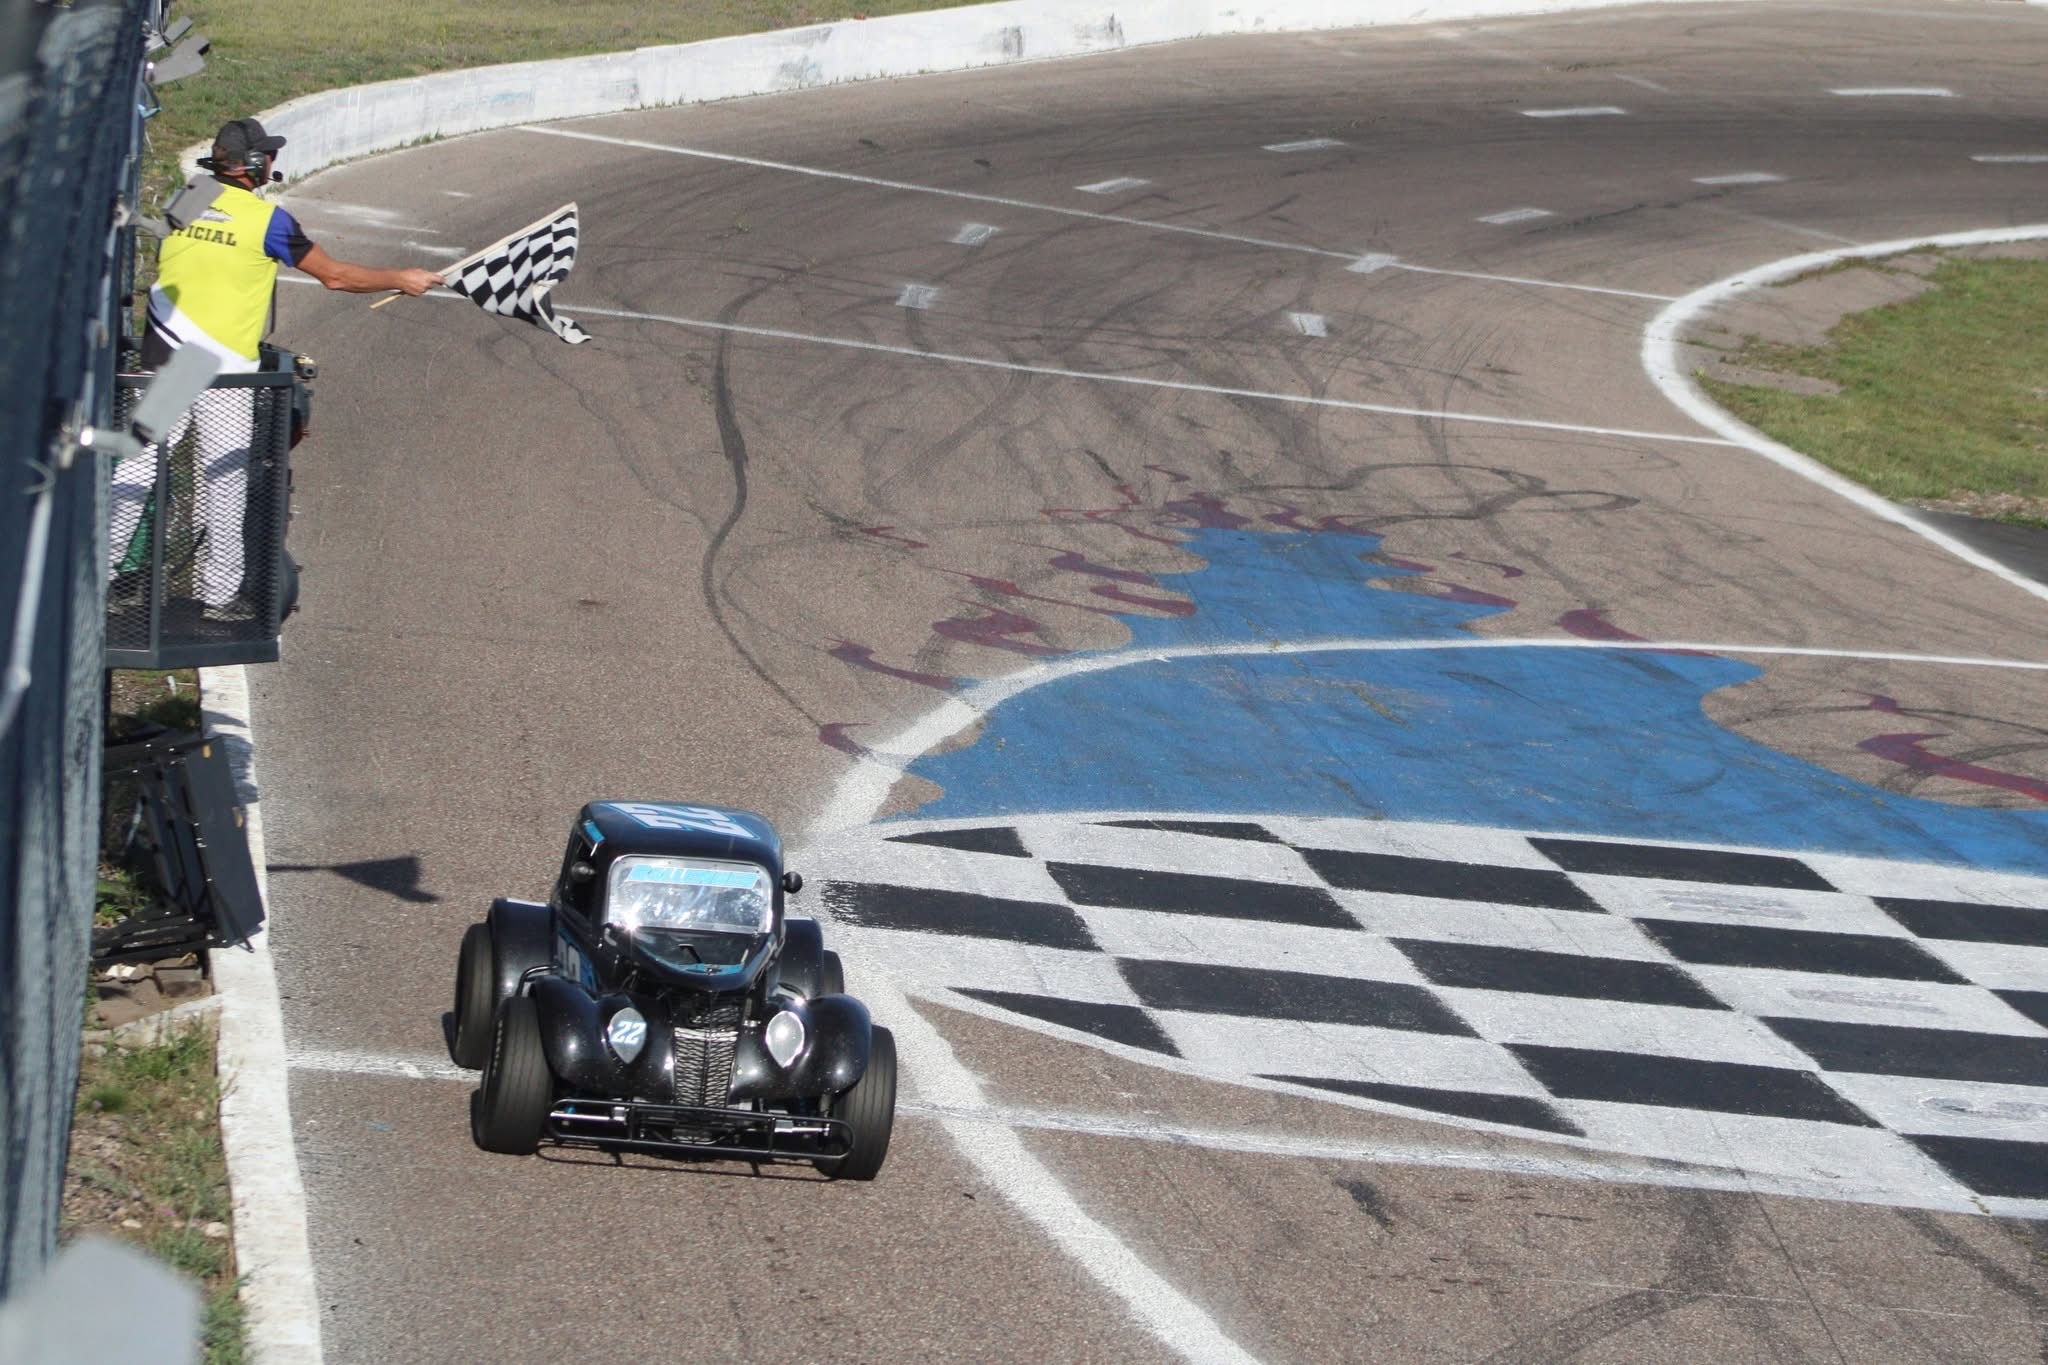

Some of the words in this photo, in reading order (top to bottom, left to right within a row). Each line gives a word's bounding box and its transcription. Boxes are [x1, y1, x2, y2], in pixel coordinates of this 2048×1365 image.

[168, 225, 237, 247] ICIAL
[607, 802, 756, 839] 22
[610, 1020, 647, 1044] 22
